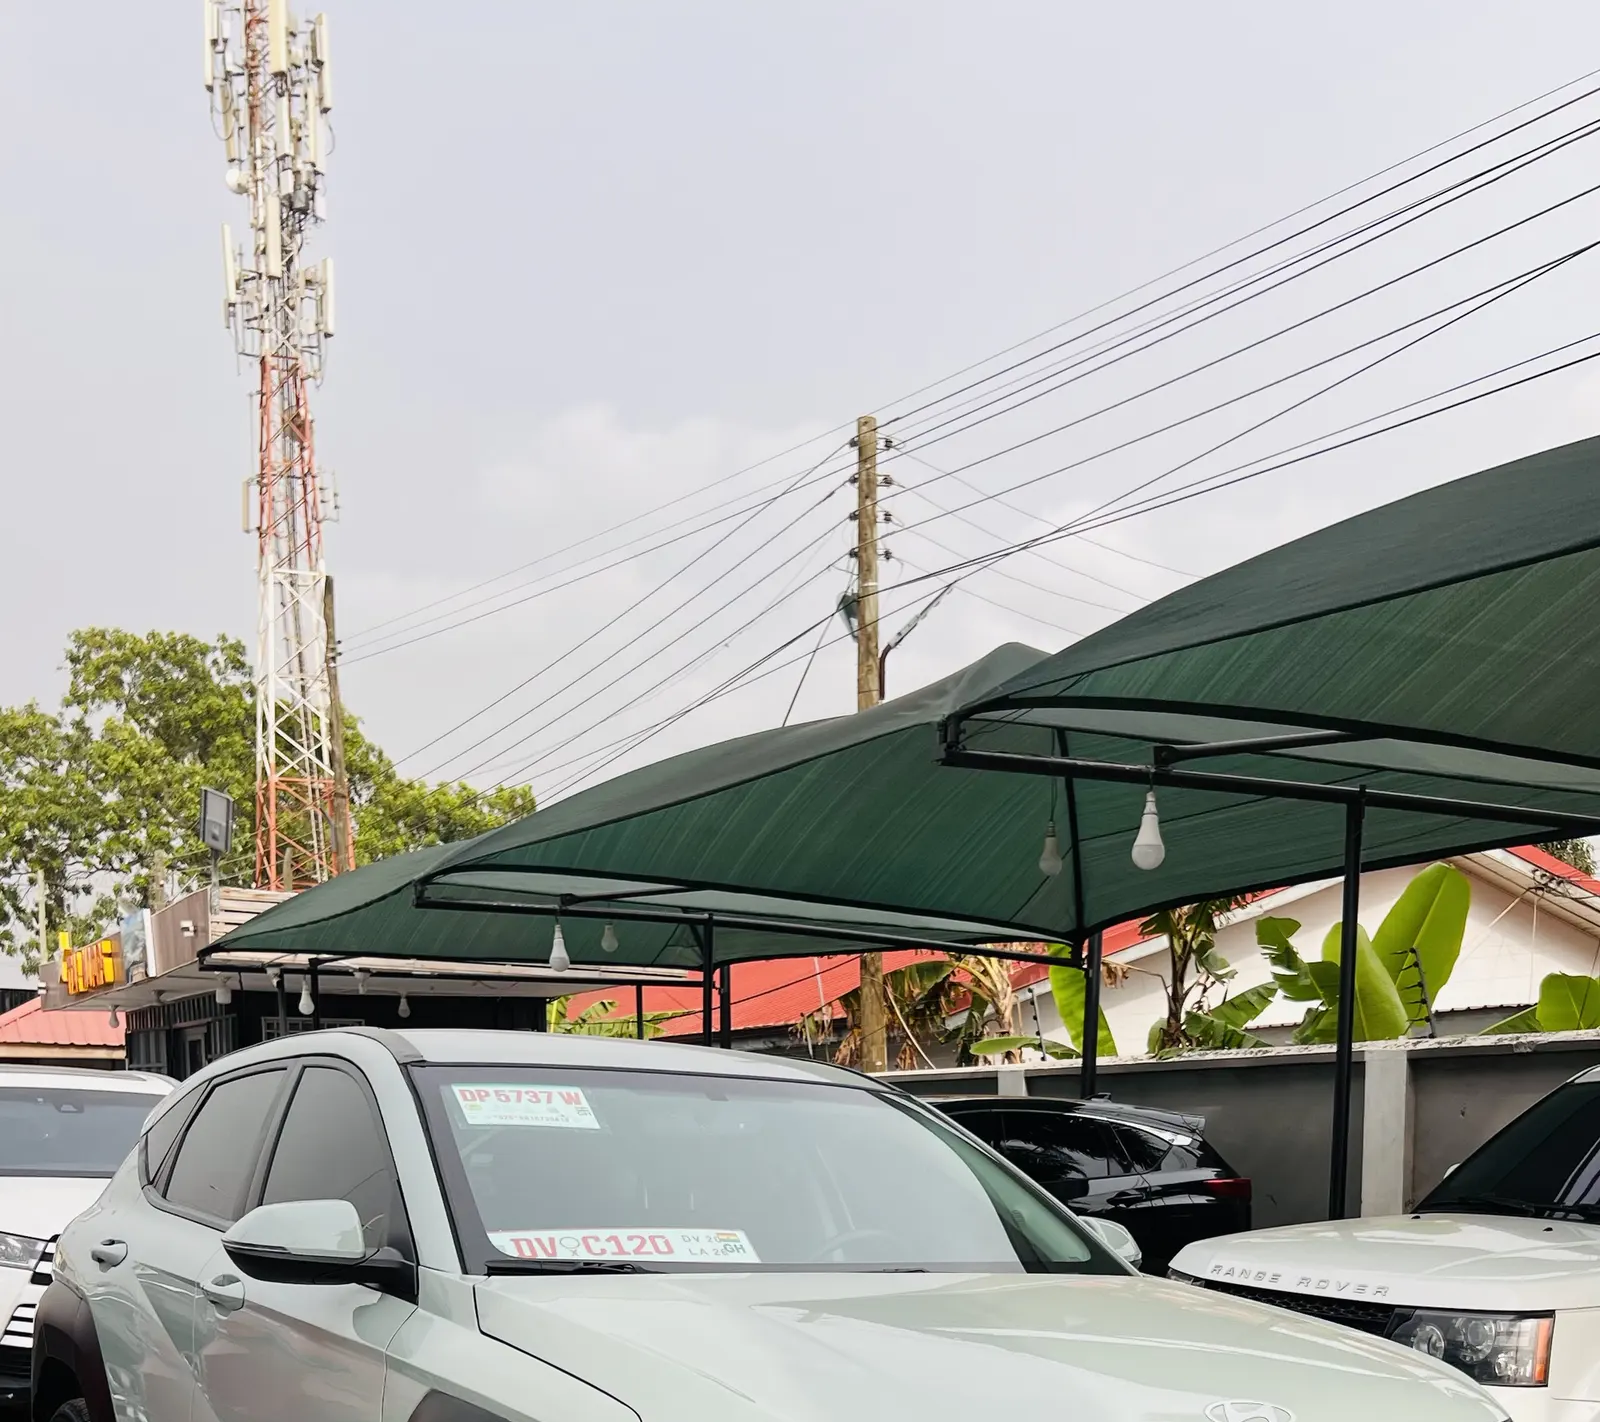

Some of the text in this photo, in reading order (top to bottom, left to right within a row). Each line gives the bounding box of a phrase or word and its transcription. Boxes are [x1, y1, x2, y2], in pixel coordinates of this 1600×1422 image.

[458, 1088, 583, 1106] DP 5737 W
[681, 1234, 700, 1243] DV
[510, 1236, 558, 1260] DV
[688, 1248, 709, 1256] LA
[723, 1242, 747, 1254] GH
[1210, 1263, 1390, 1298] RANGE ROVER
